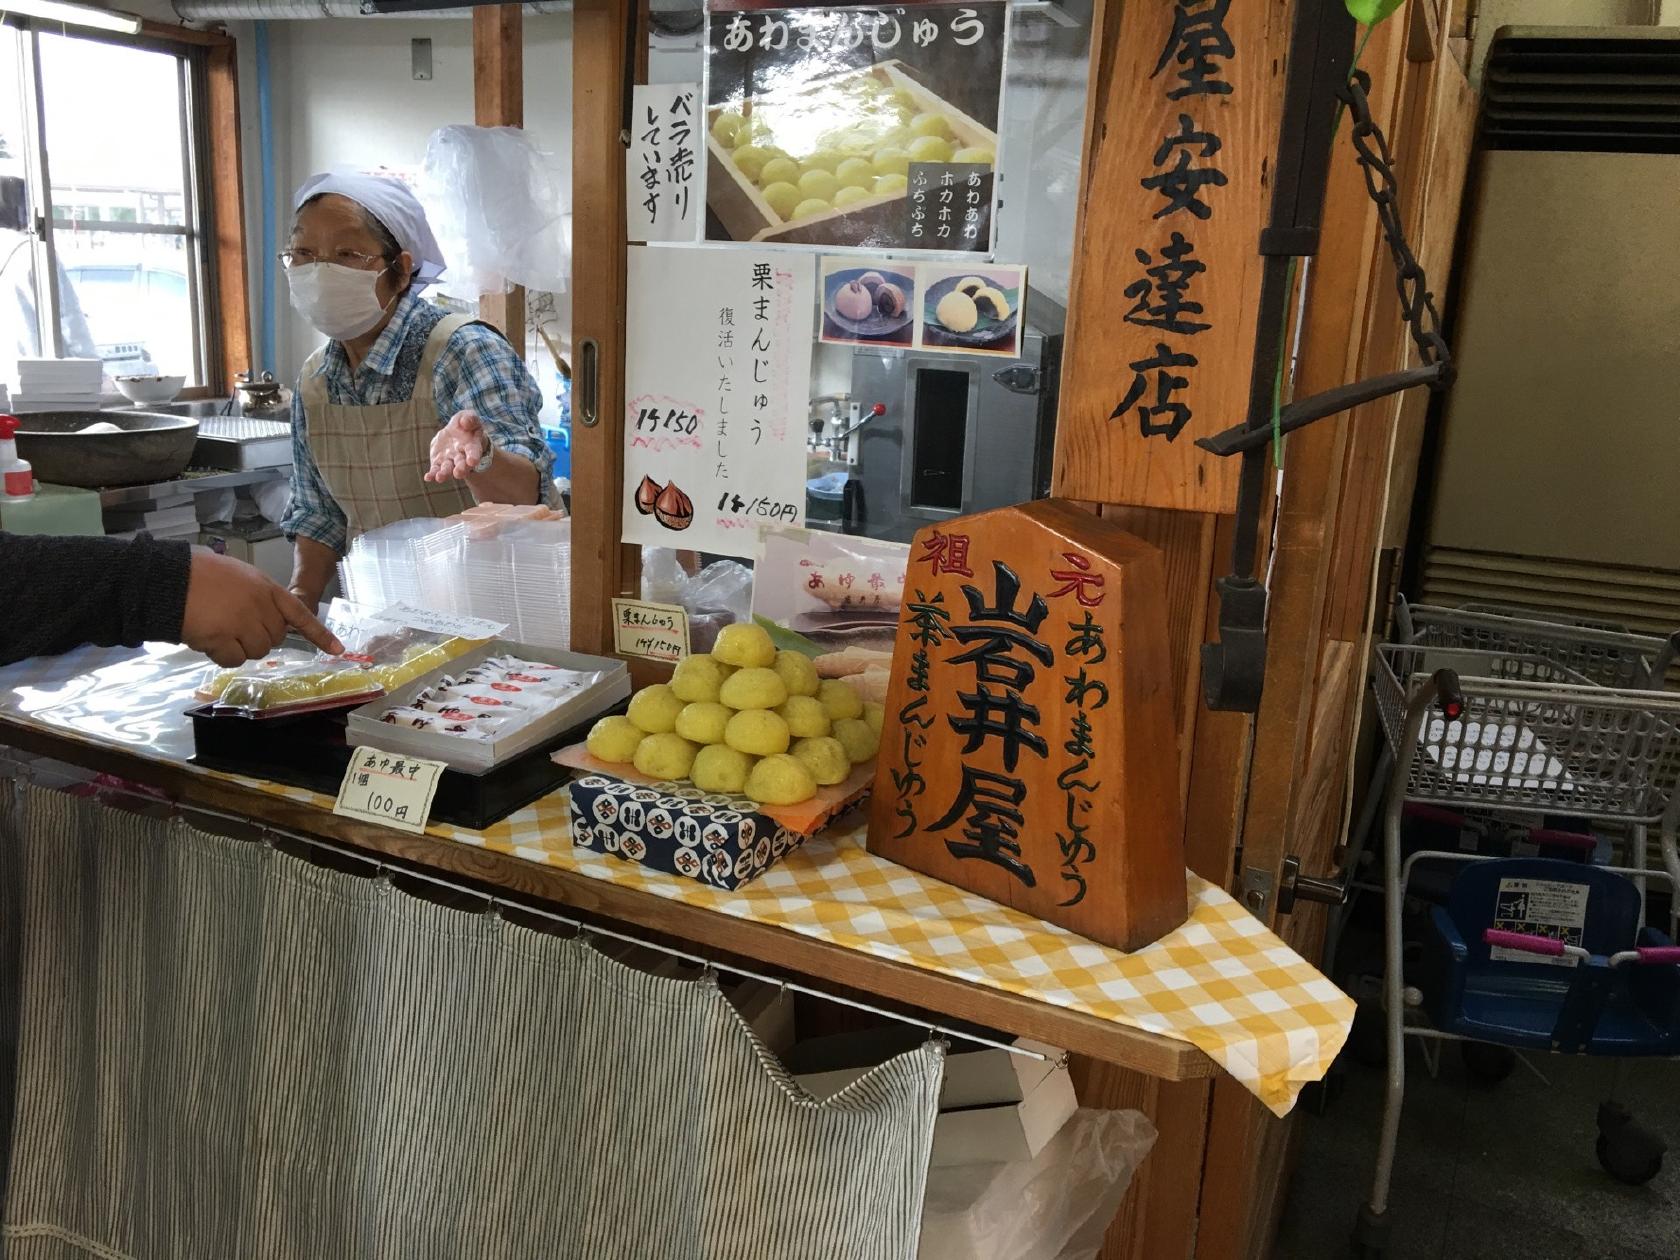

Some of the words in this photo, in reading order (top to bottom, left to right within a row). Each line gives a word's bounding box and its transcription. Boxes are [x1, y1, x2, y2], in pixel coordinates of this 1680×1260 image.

[641, 105, 660, 224] しています
[666, 92, 693, 220] バラ売り
[937, 171, 954, 238] ホカホカ
[963, 171, 981, 239] あわあわ
[715, 306, 736, 479] 復活いたしました
[750, 262, 774, 446] 栗まんじゅう
[364, 755, 421, 780] あゆ最中
[923, 559, 1054, 888] 岩井屋
[367, 792, 408, 819] 100円
